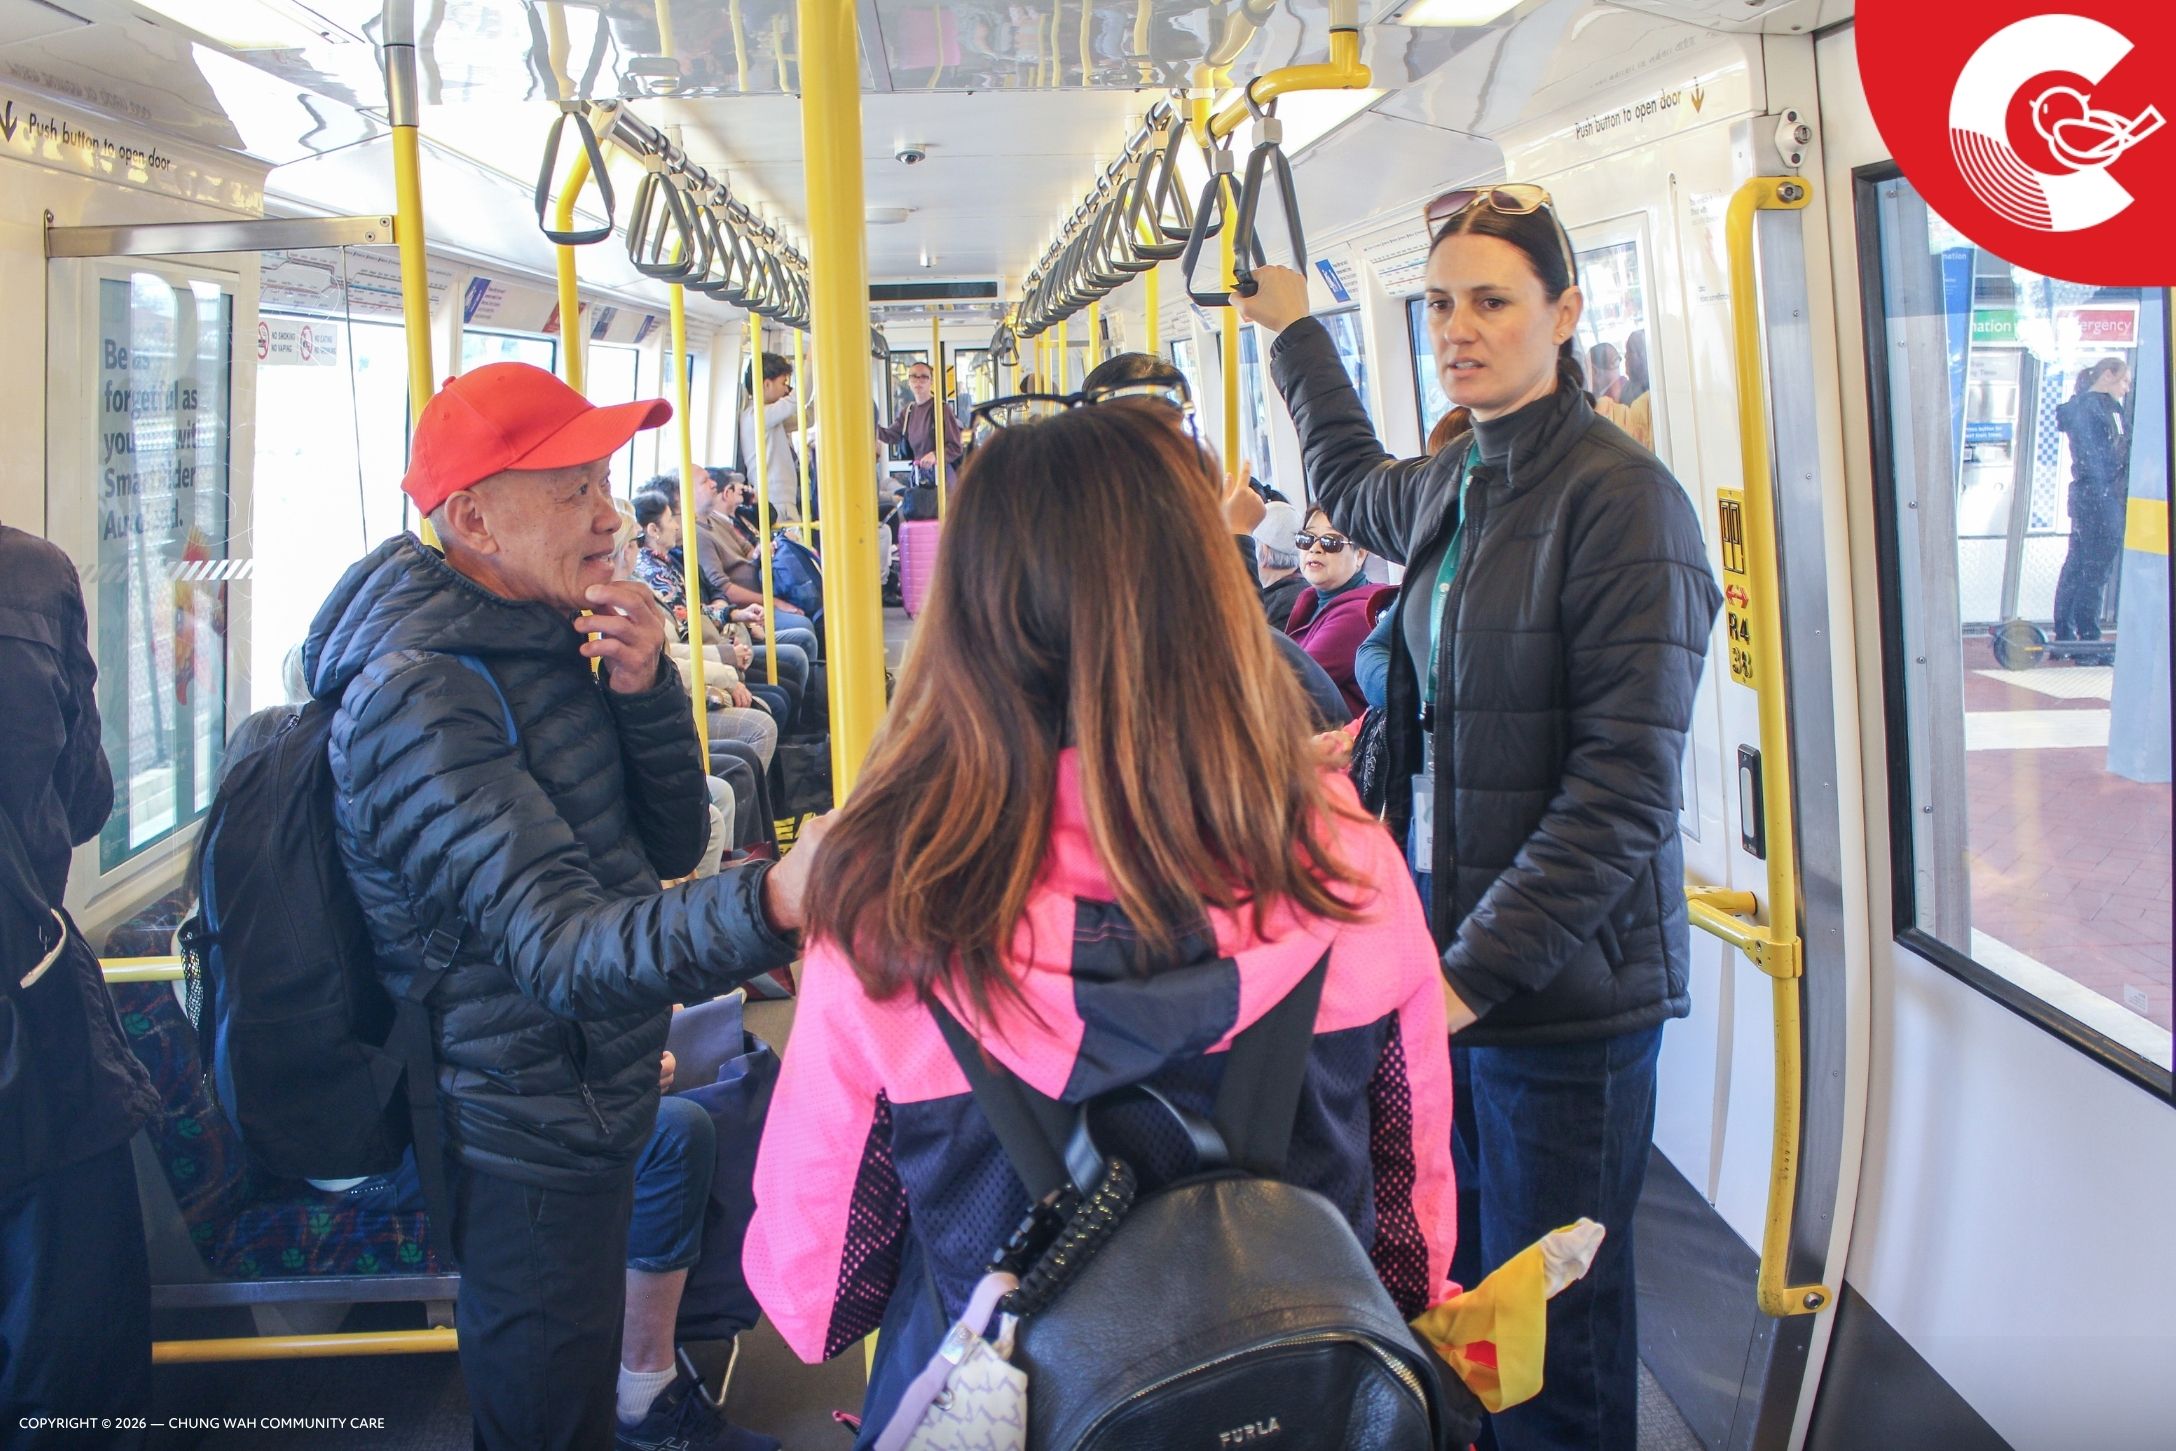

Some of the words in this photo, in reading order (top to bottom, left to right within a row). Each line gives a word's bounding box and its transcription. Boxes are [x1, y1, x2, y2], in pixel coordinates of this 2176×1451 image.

[1575, 117, 1593, 139] Push
[1594, 114, 1621, 133] button
[1623, 108, 1632, 123] to
[1635, 100, 1658, 122] open
[1660, 88, 1682, 110] door
[29, 112, 57, 140] Push
[62, 121, 99, 149] button
[104, 138, 115, 155] to
[119, 146, 145, 166] open
[148, 147, 171, 171] door
[2080, 320, 2132, 336] ergency
[104, 338, 128, 370] Be
[182, 388, 198, 410] as
[175, 419, 200, 450] wit
[1727, 611, 1751, 645] R4
[1218, 1416, 1281, 1448] FURLA
